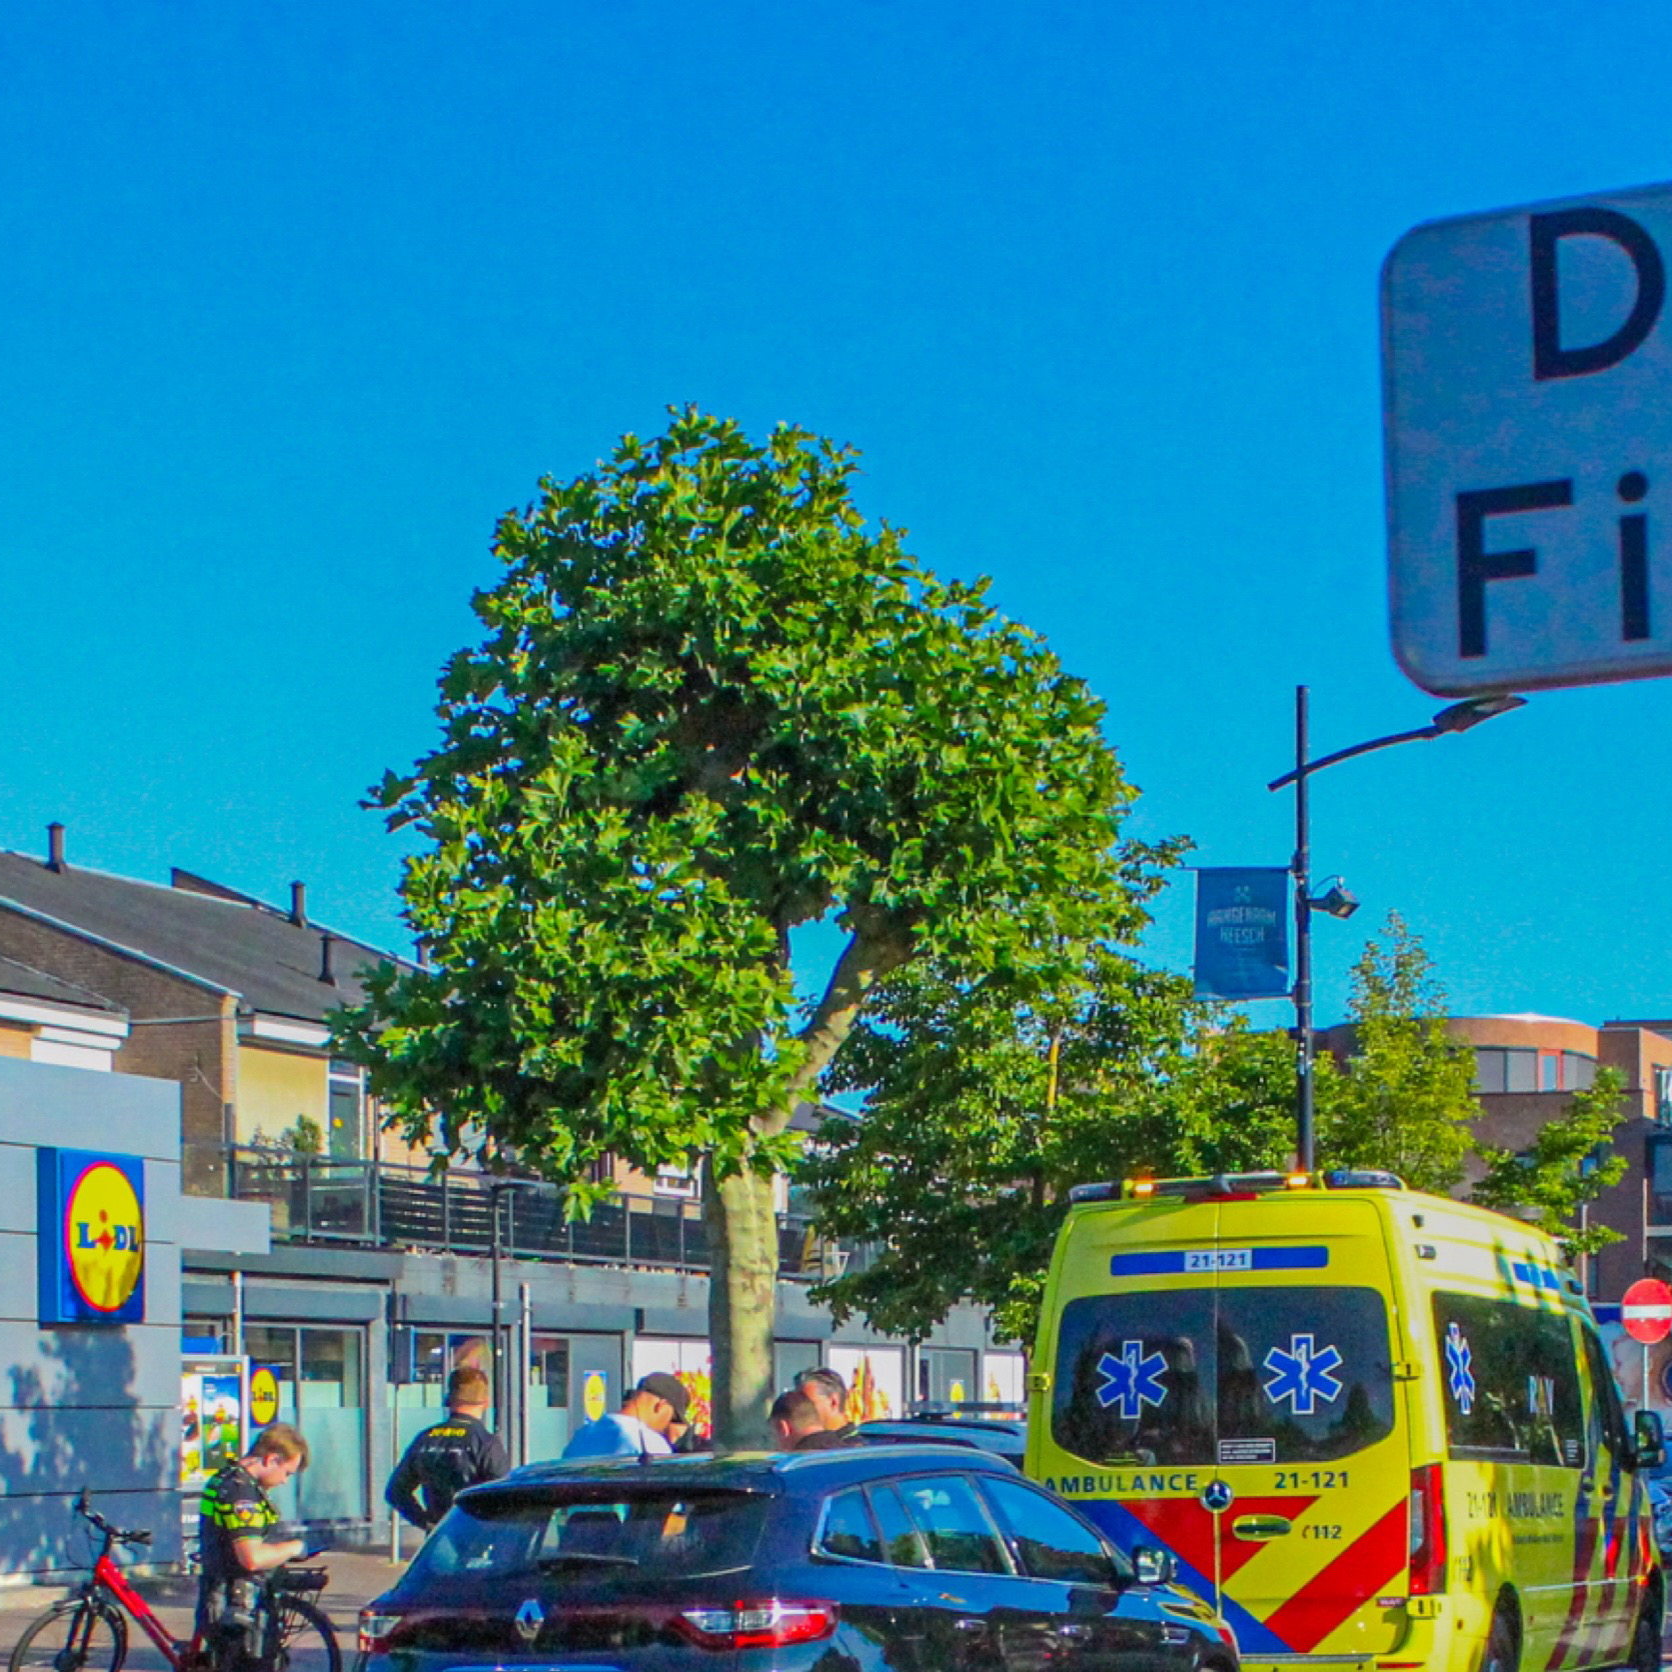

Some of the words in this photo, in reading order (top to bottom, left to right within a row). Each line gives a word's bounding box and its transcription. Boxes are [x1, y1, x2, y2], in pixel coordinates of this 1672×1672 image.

[1190, 1252, 1247, 1269] 21-121
[1045, 1473, 1198, 1494] AMBULANCE
[1274, 1470, 1350, 1489] 21-121
[1312, 1524, 1342, 1540] 112
